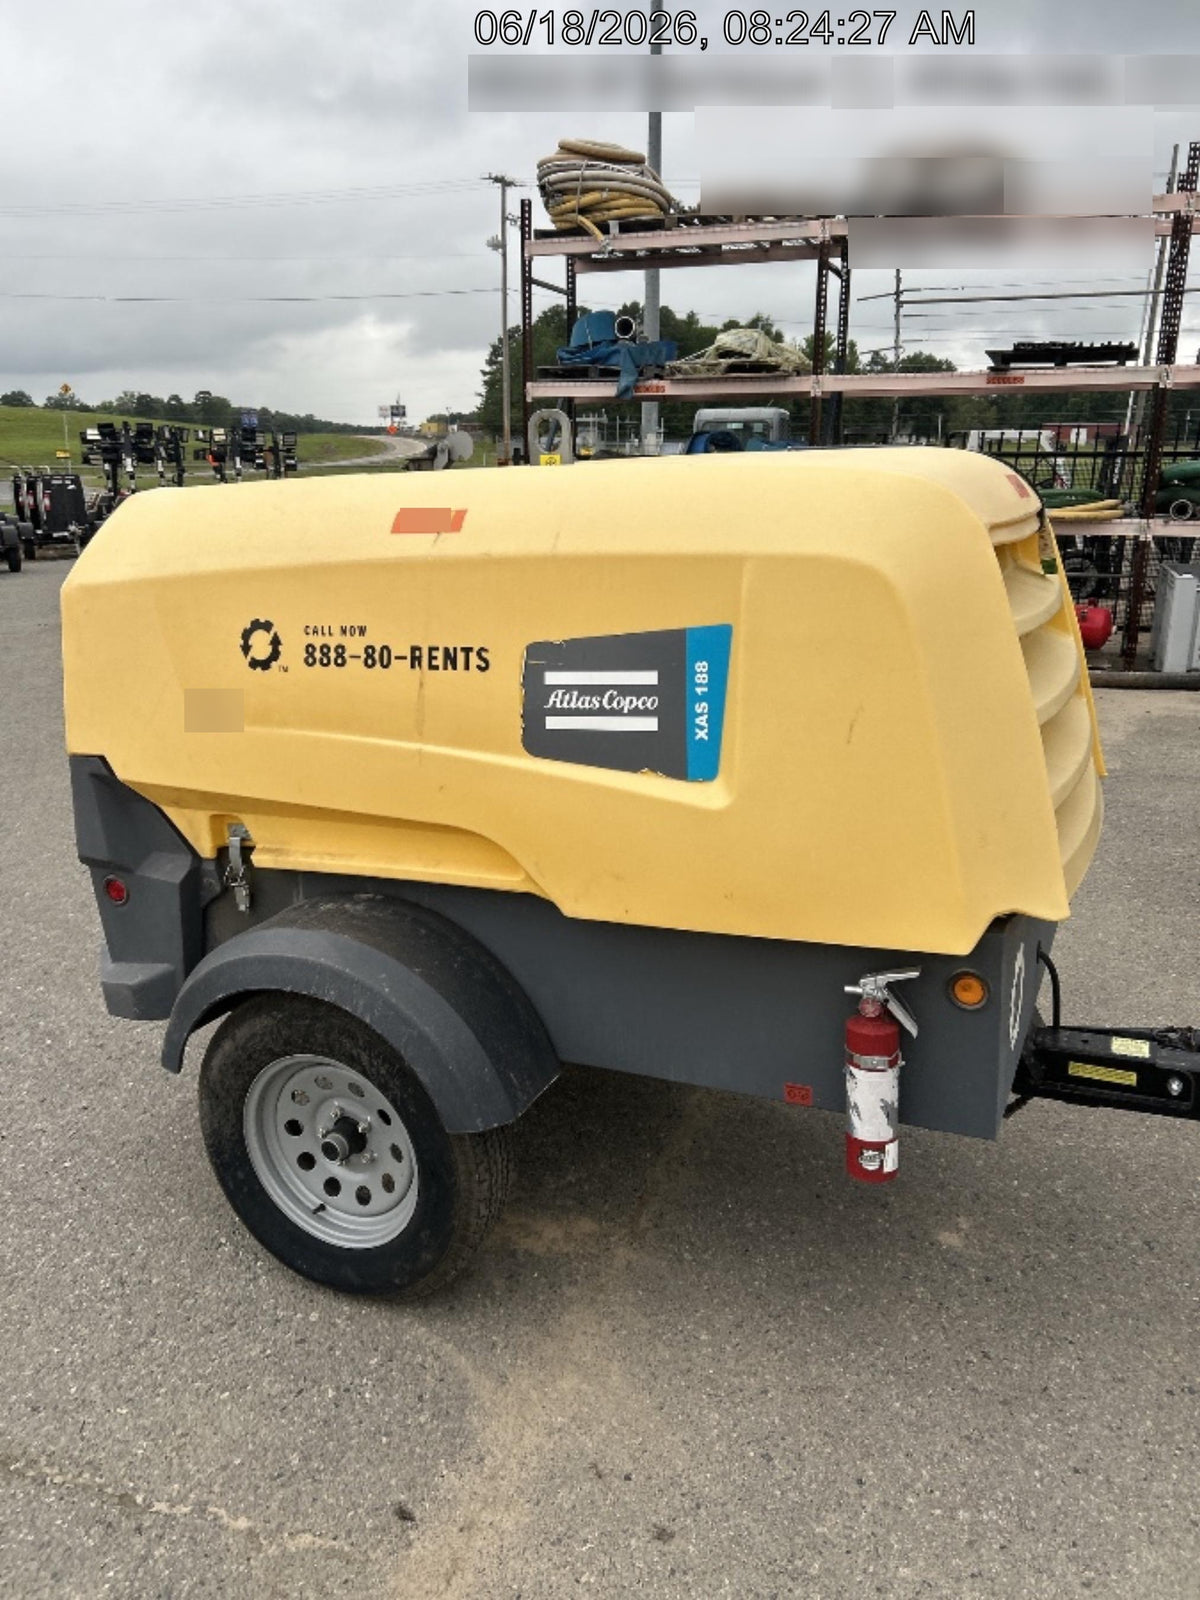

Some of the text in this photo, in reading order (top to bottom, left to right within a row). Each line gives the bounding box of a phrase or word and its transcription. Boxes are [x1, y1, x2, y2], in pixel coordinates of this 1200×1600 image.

[303, 625, 367, 637] CALL NOW
[303, 643, 490, 672] 888-80-RENTS
[543, 689, 659, 713] Atlas Copco
[694, 660, 709, 740] XAS 188
